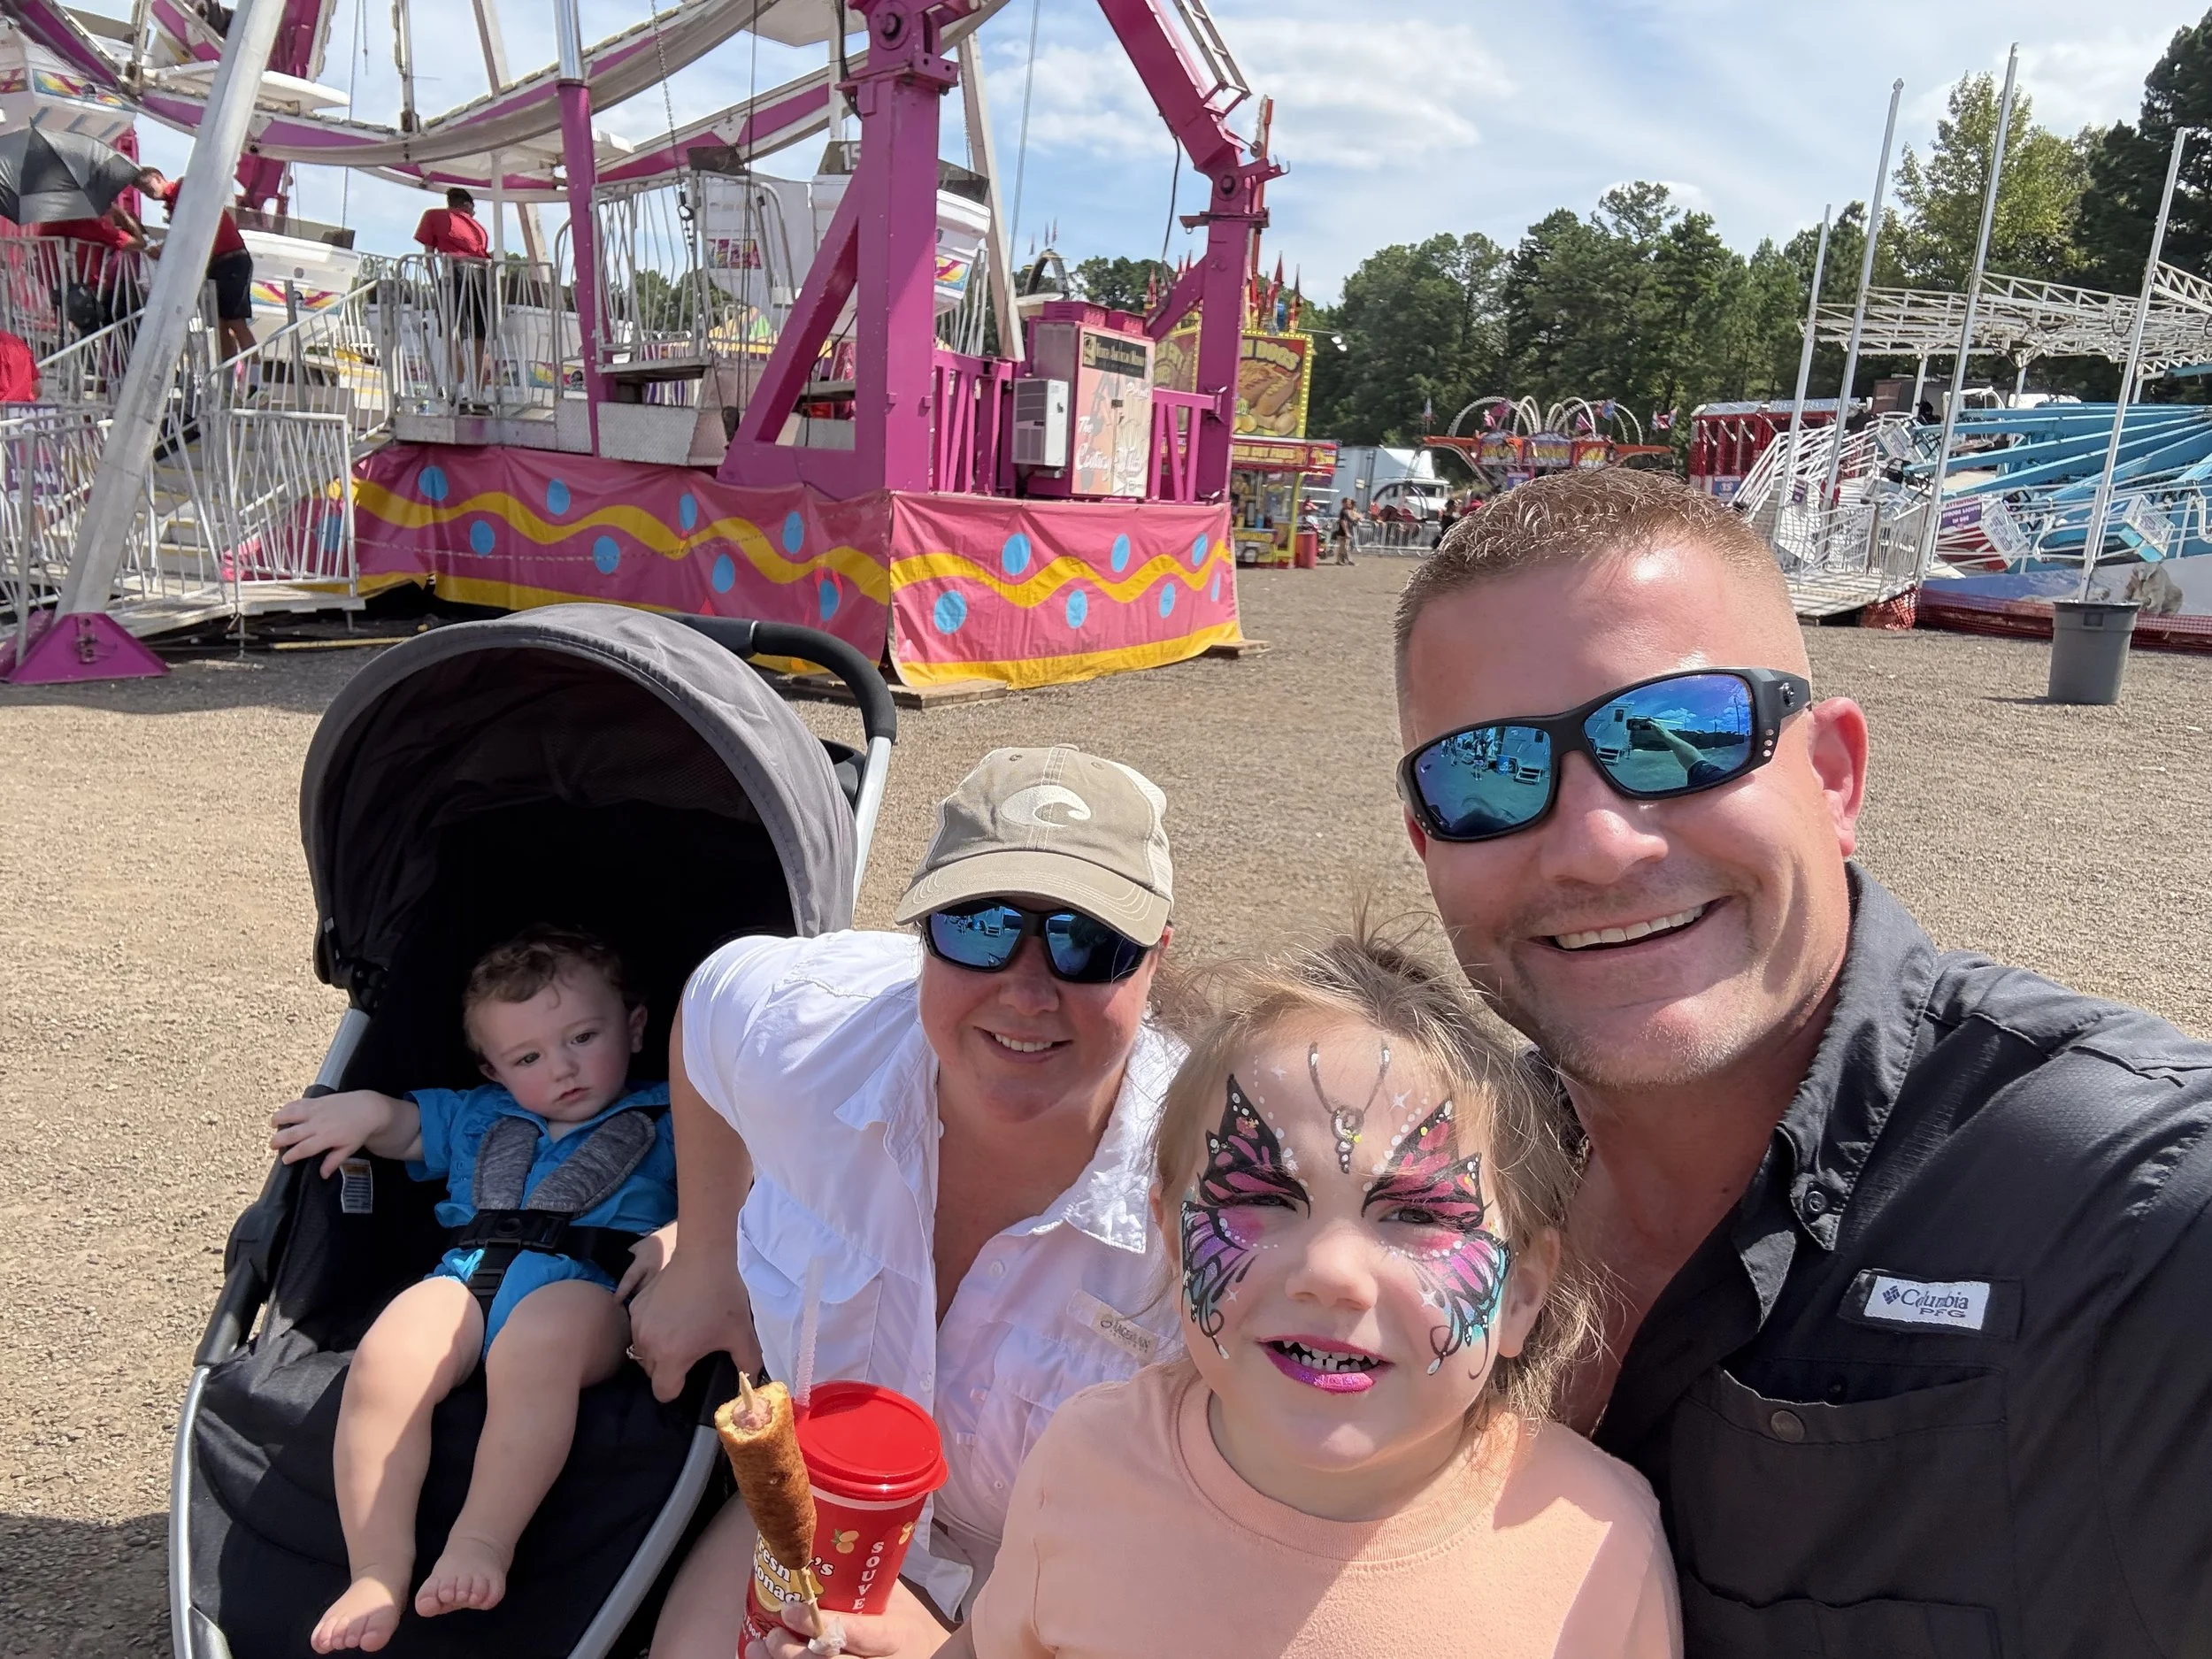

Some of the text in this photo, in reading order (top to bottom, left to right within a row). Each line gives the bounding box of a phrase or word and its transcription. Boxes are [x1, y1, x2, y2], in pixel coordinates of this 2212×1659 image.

[1946, 496, 1978, 508] ATTENTION
[1919, 1308, 1966, 1318] PFG
[852, 1541, 884, 1613] SOUVE
